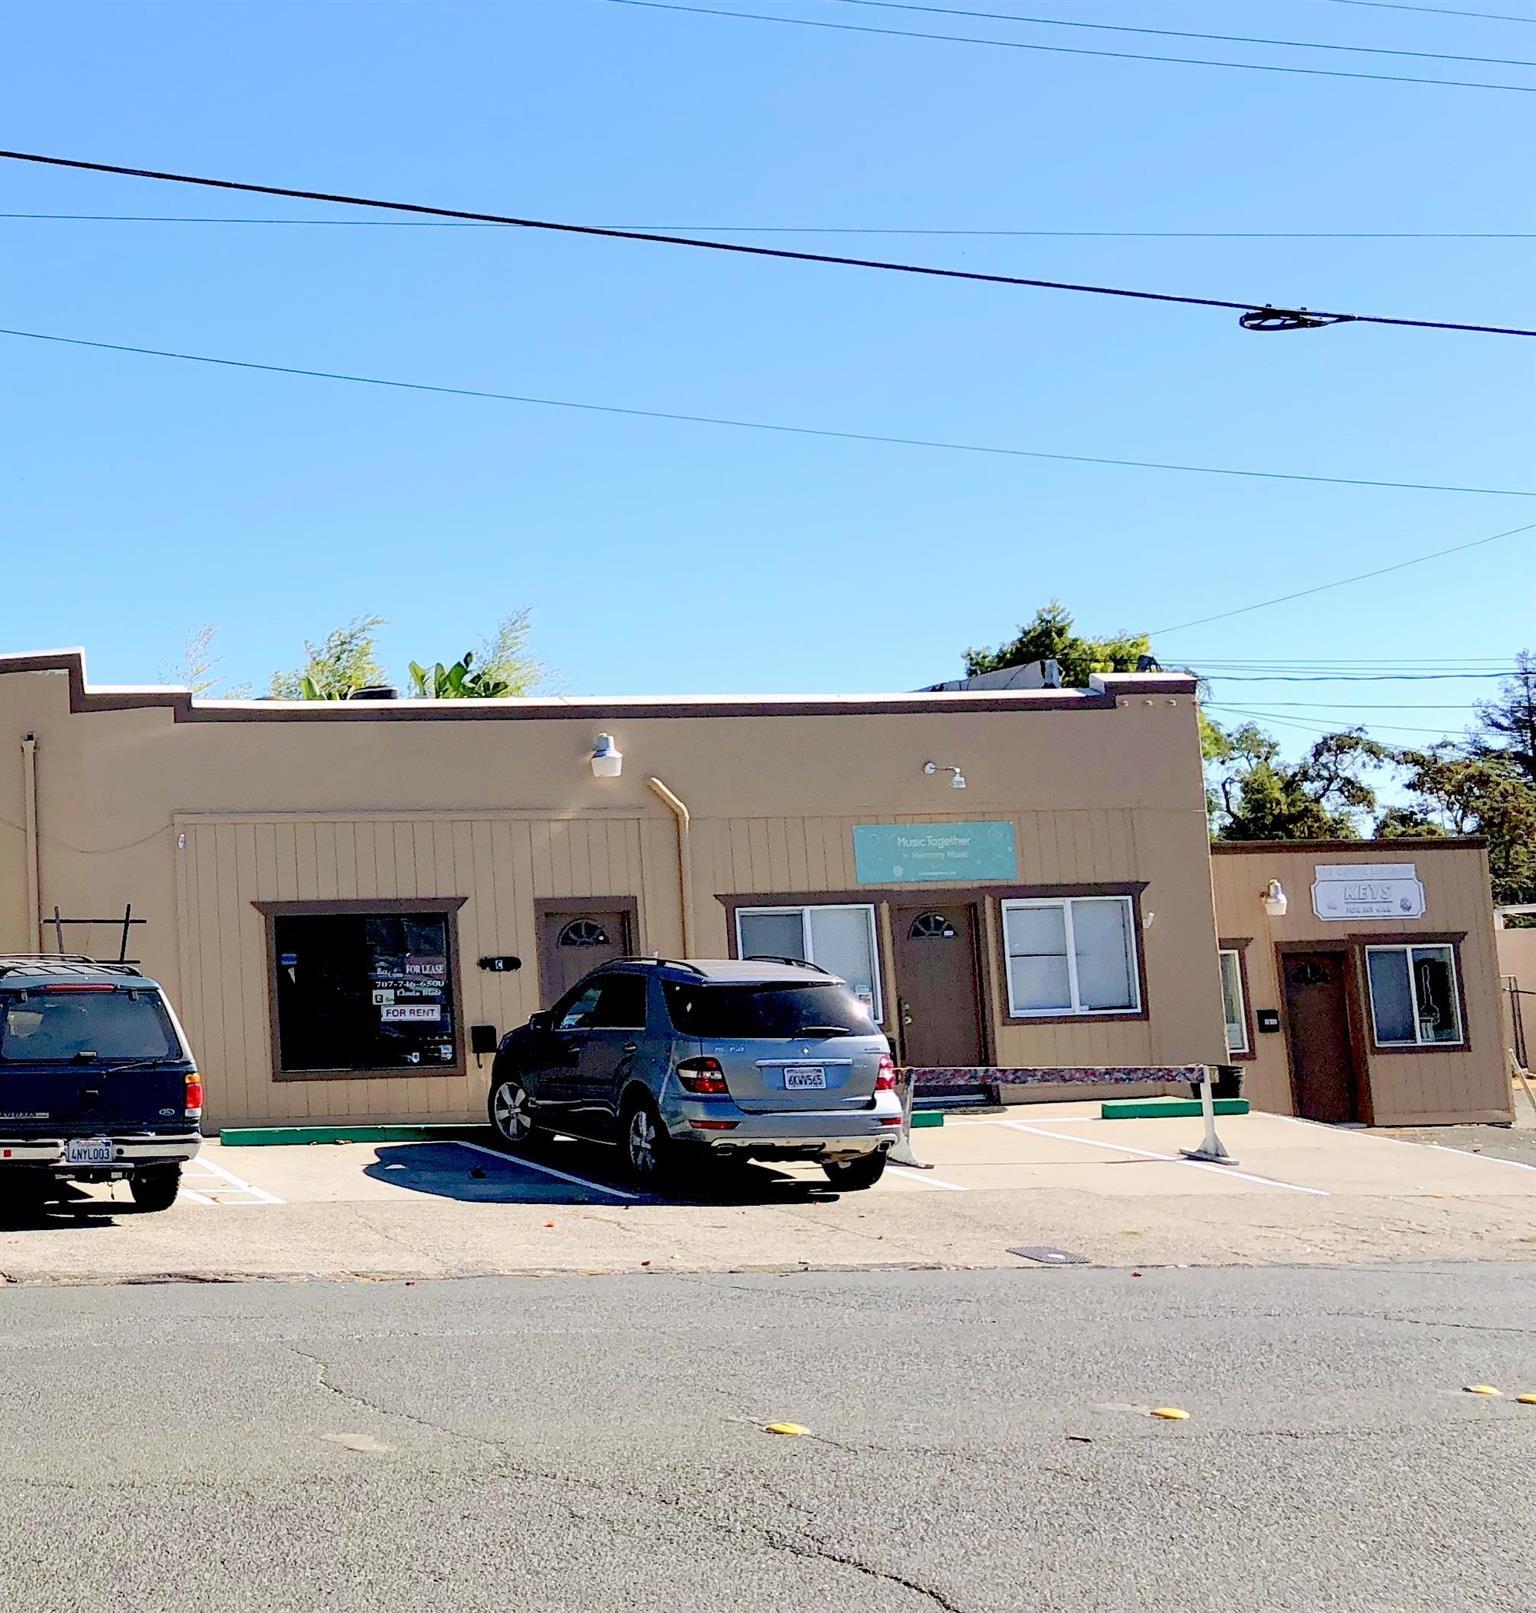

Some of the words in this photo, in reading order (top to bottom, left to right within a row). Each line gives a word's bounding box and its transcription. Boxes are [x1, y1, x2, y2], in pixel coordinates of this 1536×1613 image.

[1344, 884, 1392, 901] KEYS
[405, 964, 421, 974] FOR
[421, 964, 445, 974] LEASE
[386, 1008, 407, 1018] FOR
[409, 1008, 436, 1017] RENT
[71, 1147, 110, 1160] 4NYL003
